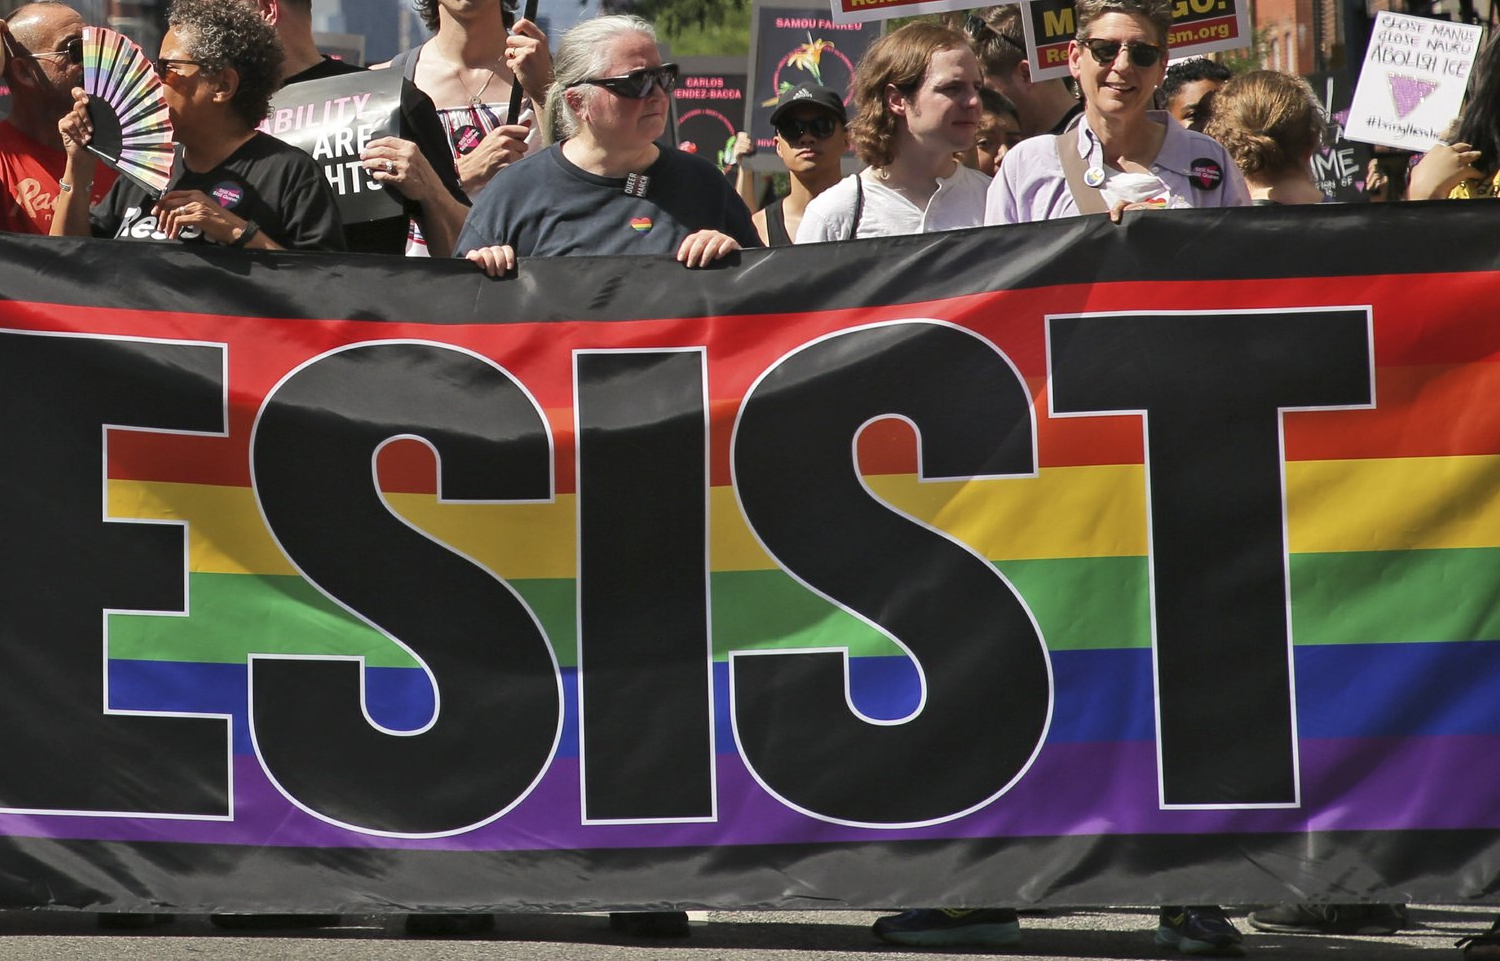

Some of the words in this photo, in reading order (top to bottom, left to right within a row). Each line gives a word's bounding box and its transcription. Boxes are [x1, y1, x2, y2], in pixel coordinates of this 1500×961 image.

[1382, 16, 1426, 32] CLOSE
[1378, 30, 1421, 47] CLOSE
[1371, 45, 1437, 73] ABOLISH
[1443, 57, 1470, 78] ICE
[686, 77, 724, 88] CARLOS
[673, 89, 741, 99] ENDEZ-BACCA
[312, 123, 374, 161] ARE
[624, 172, 637, 194] QUEER
[636, 175, 649, 197] MARCH
